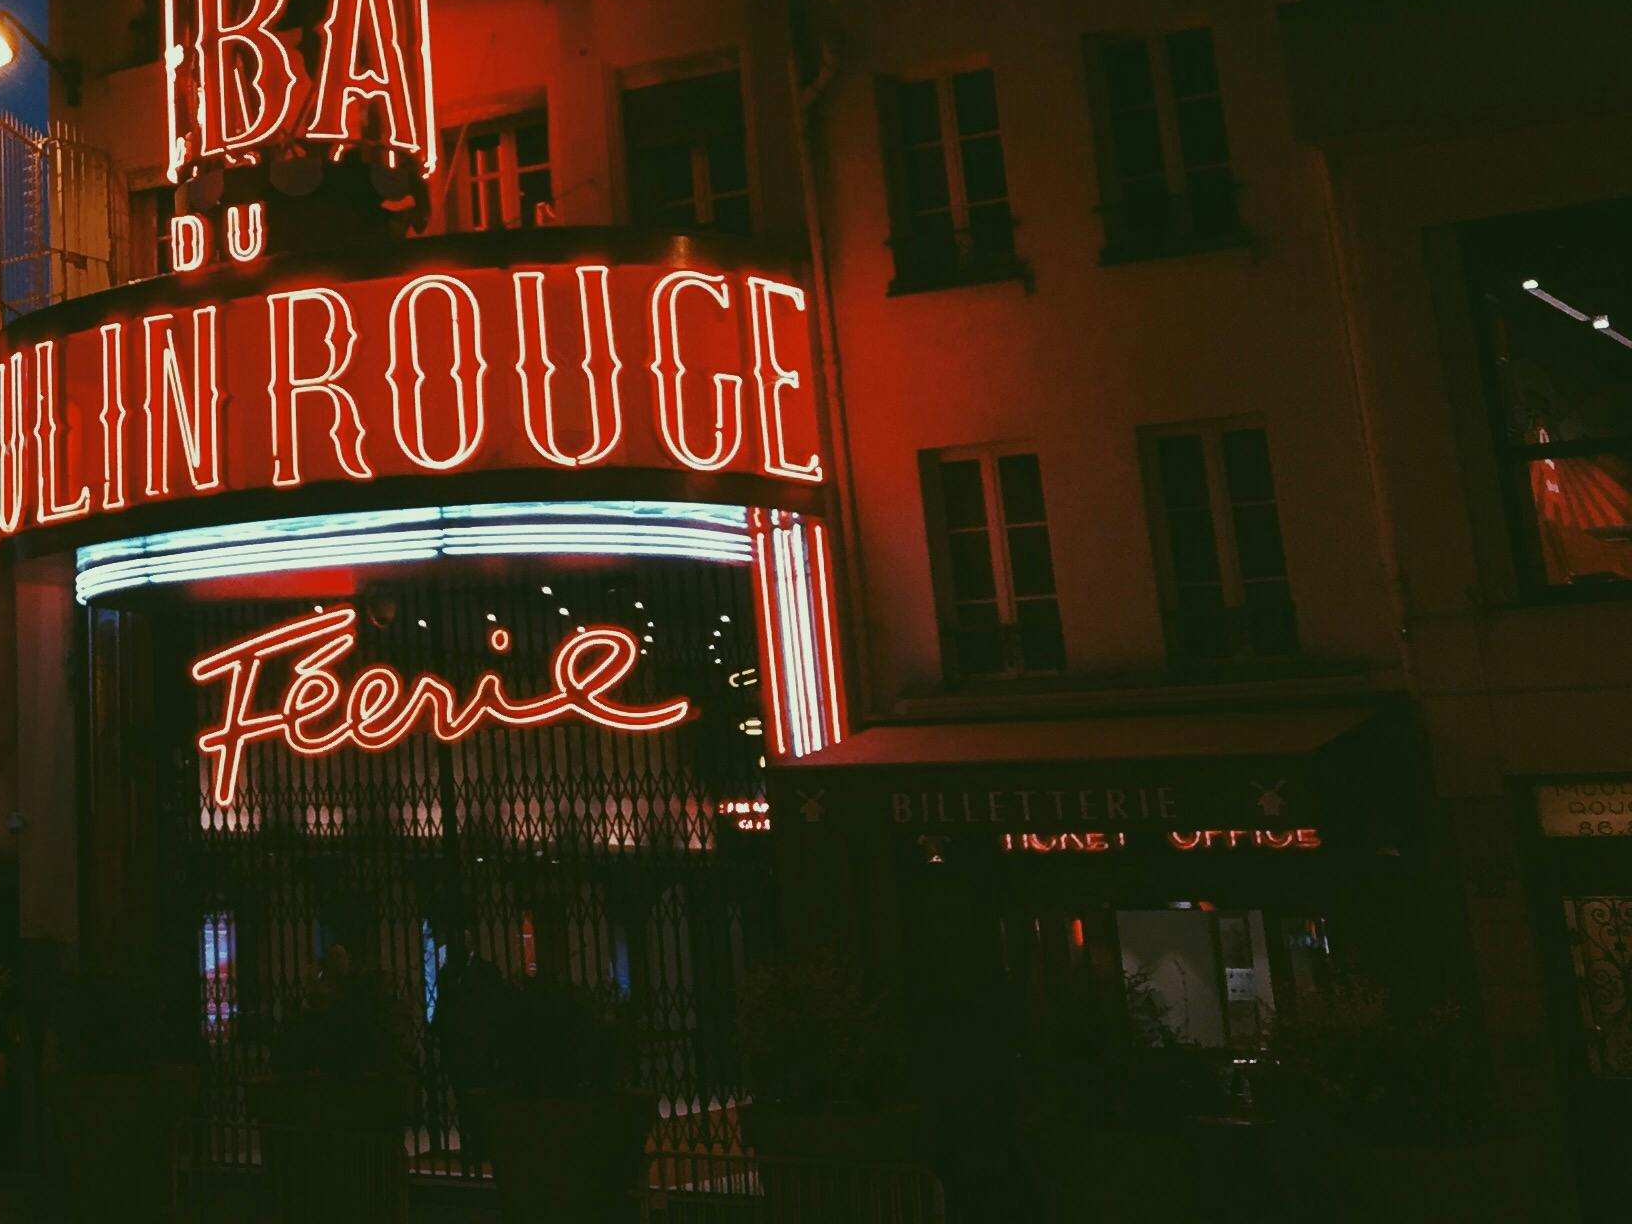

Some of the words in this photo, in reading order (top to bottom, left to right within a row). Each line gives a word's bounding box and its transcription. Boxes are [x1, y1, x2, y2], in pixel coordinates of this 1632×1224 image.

[171, 203, 264, 272] DU
[267, 265, 823, 486] ROUGE
[890, 786, 1177, 824] BILLETTERIE
